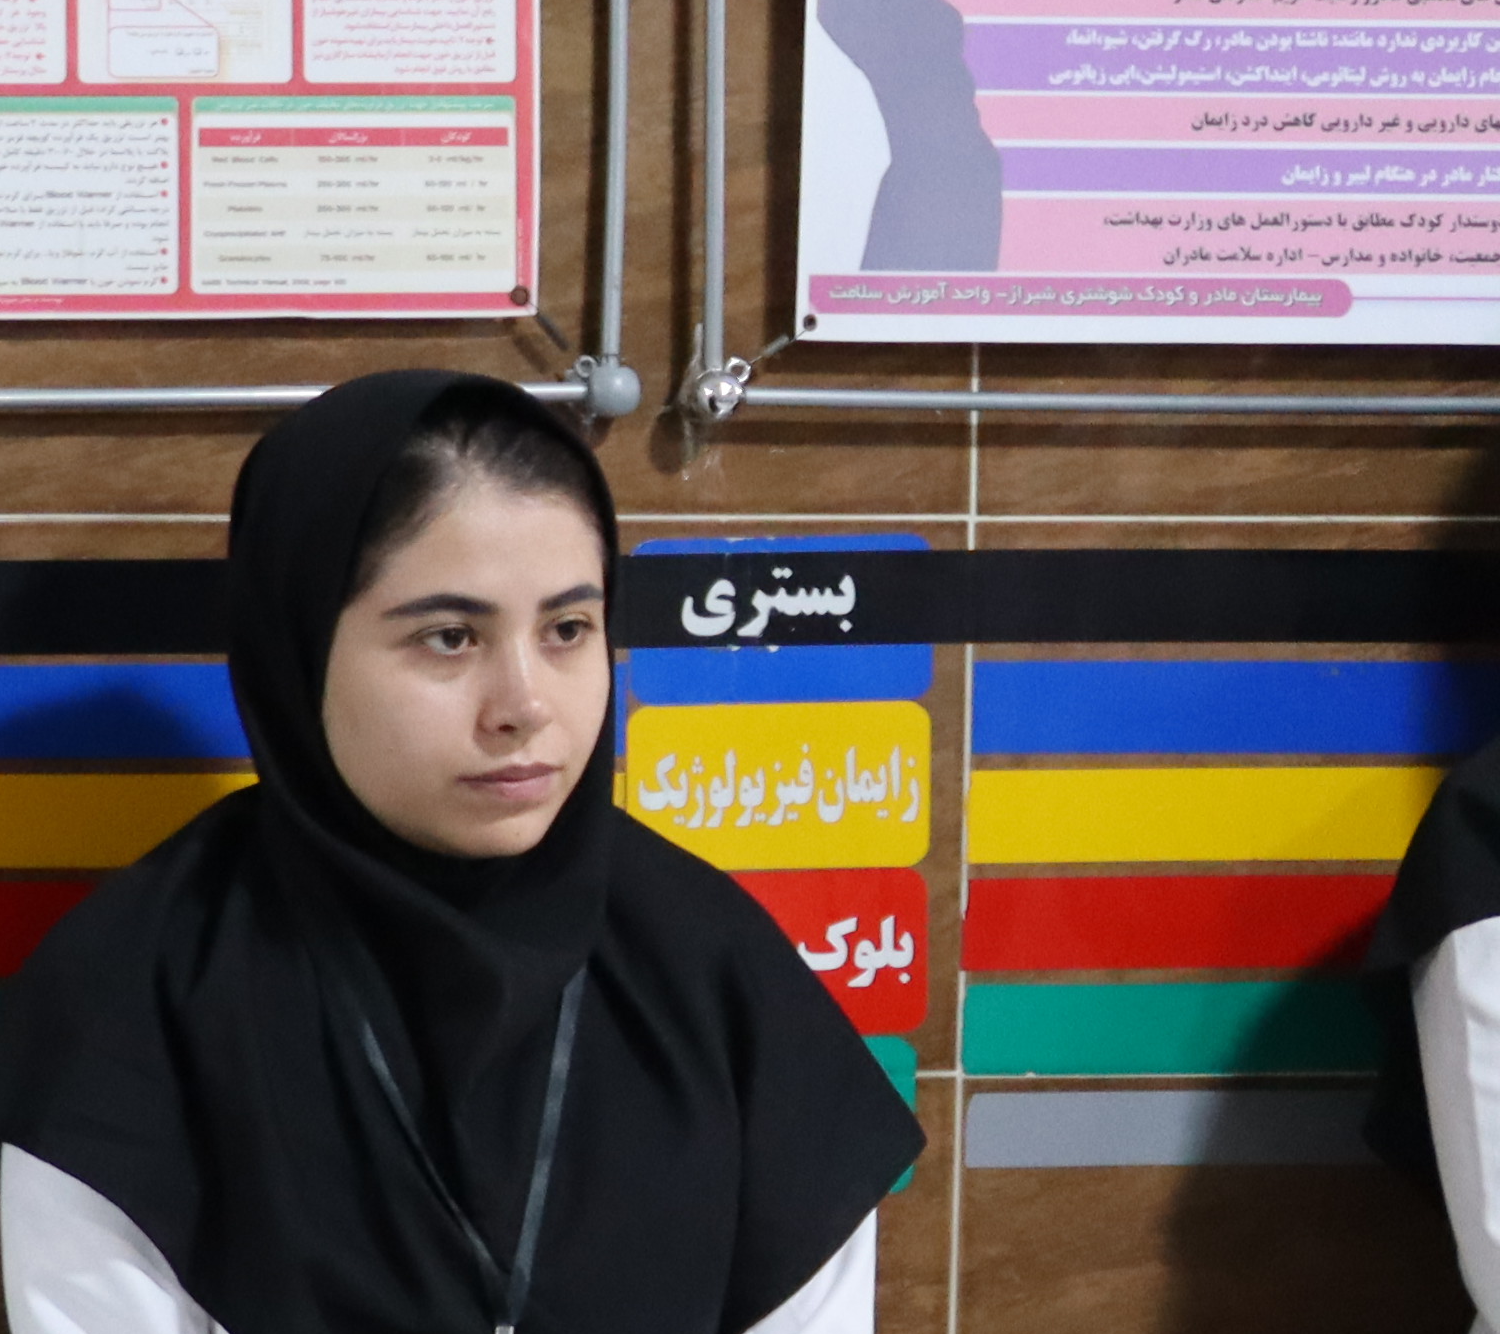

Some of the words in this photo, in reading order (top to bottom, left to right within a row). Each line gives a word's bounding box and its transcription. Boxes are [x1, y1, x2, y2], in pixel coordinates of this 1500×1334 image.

[1190, 111, 1238, 132] زایمان
[1242, 111, 1268, 132] درد
[1273, 111, 1316, 132] کاهش
[1321, 111, 1373, 132] دارویی
[1378, 111, 1401, 132] غیر
[1405, 111, 1414, 132] و
[1418, 111, 1470, 132] دارویی
[1168, 213, 1214, 233] وزارت
[1218, 213, 1246, 233] های
[1337, 213, 1348, 233] با
[1352, 213, 1395, 233] مطابق
[1400, 213, 1443, 233] کودک
[1162, 247, 1211, 268] مادران
[1216, 247, 1264, 268] سلامت
[1267, 247, 1304, 268] اداره
[1322, 247, 1373, 268] مدارس
[1379, 247, 1387, 268] و
[1390, 247, 1442, 268] خانواده
[828, 281, 883, 307] سلامت
[887, 281, 948, 307] آموزش
[951, 281, 991, 307] واحد
[1061, 281, 1134, 307] شوشتری
[1140, 281, 1185, 307] کودک
[1190, 281, 1199, 307] و
[1203, 281, 1237, 307] مادر
[1241, 281, 1323, 307] بیمارستان
[681, 567, 856, 637] بستری
[638, 743, 816, 828] فیزیولوژیک
[817, 746, 919, 823] زایمان
[797, 915, 915, 987] بلوک
